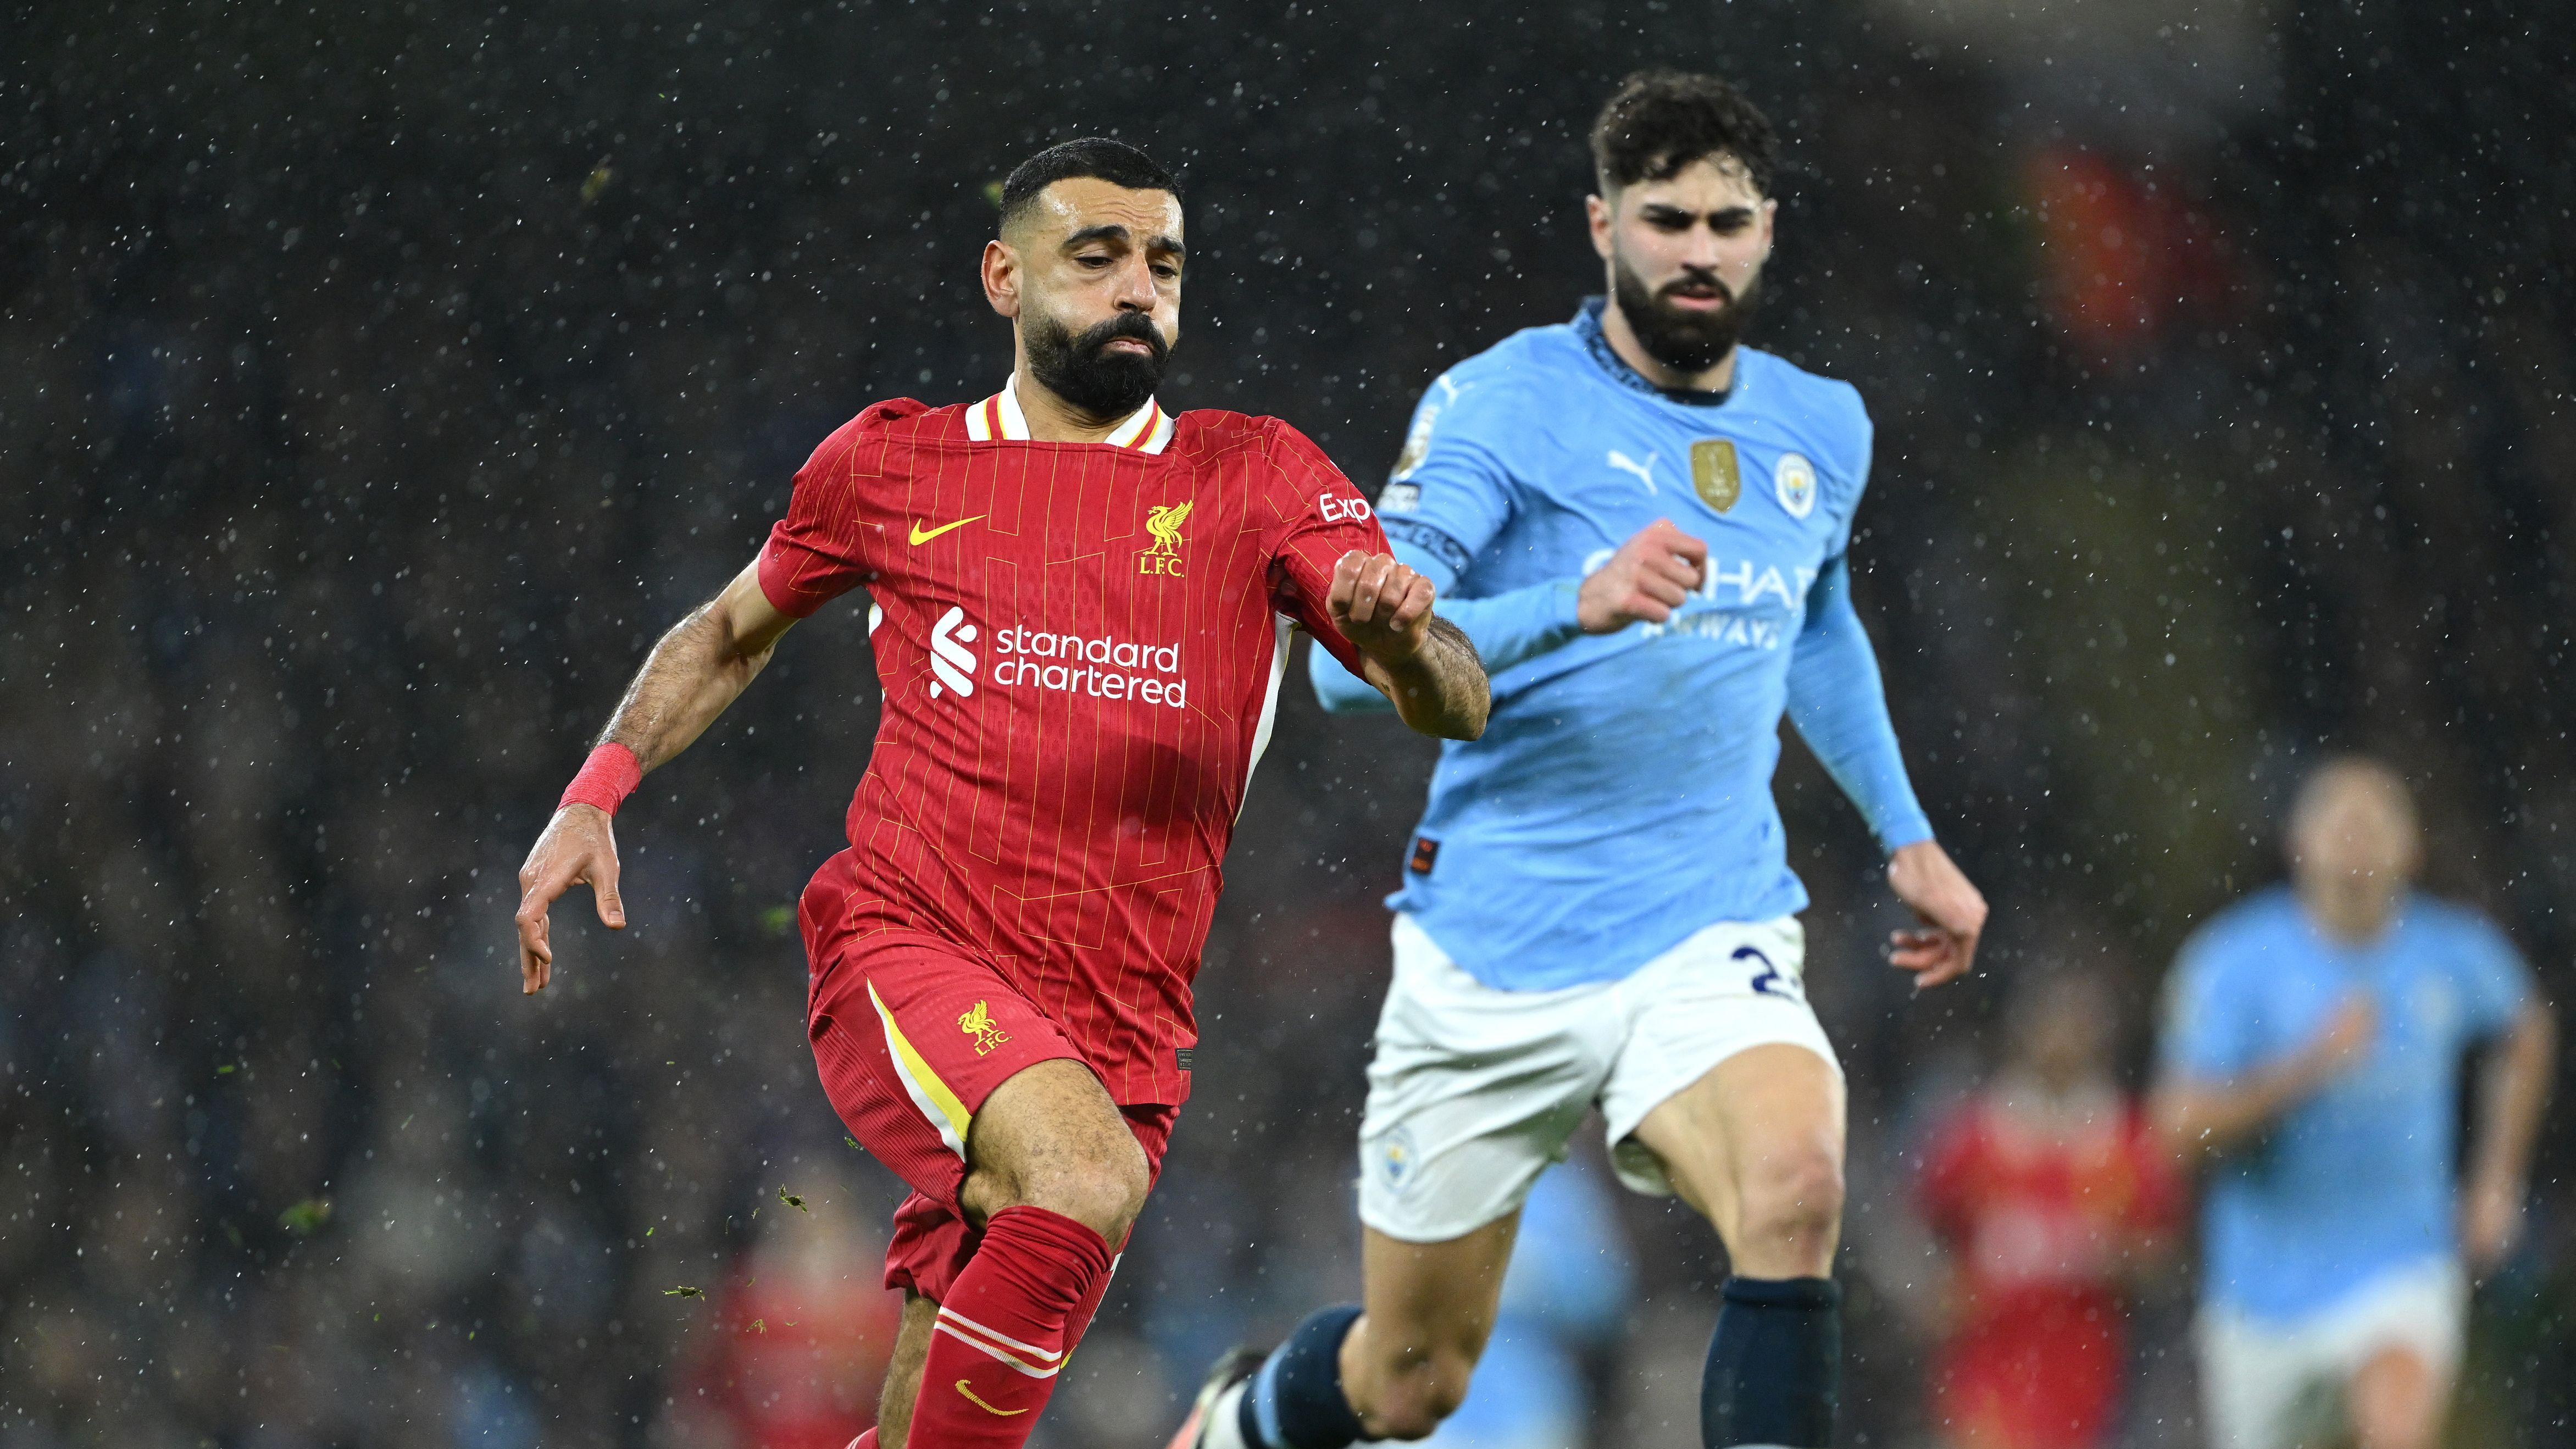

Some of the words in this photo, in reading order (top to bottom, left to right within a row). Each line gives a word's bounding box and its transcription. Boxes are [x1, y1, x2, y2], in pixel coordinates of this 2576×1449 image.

[1319, 493, 1370, 524] Exp
[1139, 557, 1185, 578] L.F.C.
[996, 624, 1178, 673] standard
[994, 656, 1186, 708] chartered
[974, 1031, 1013, 1057] L.F.C.
